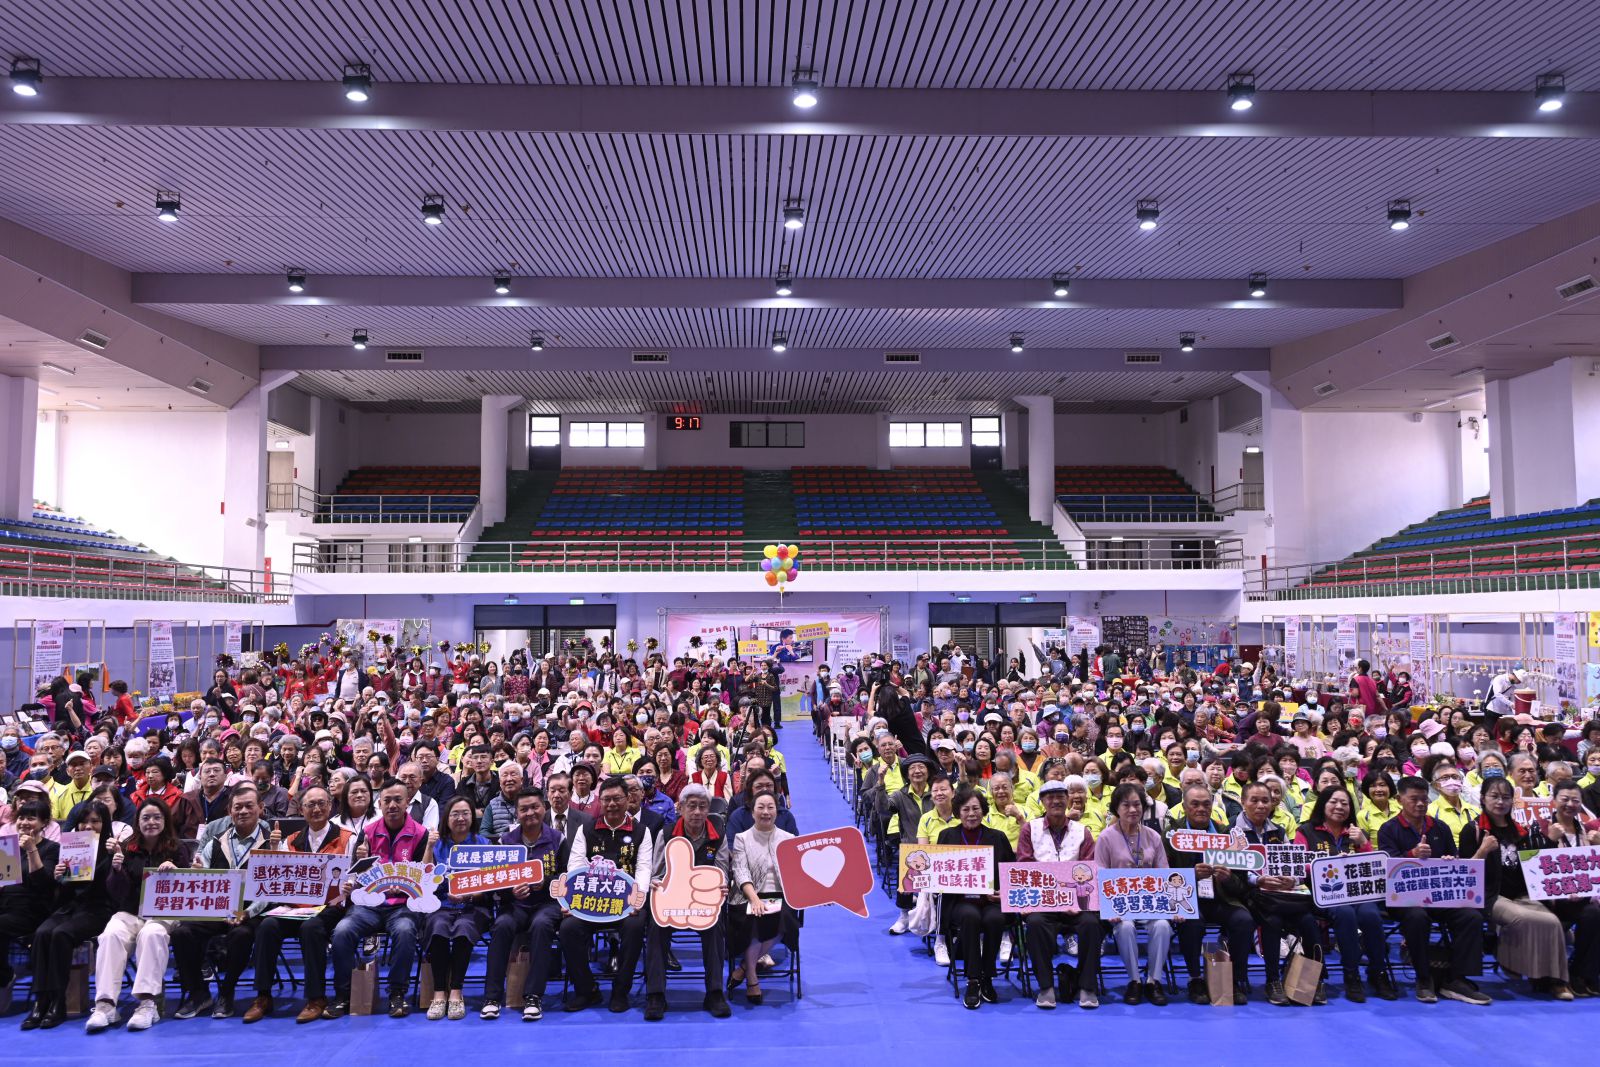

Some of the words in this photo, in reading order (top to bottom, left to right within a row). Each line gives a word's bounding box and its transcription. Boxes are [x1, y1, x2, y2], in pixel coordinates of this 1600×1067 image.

[675, 418, 700, 428] 9:17
[1177, 834, 1227, 850] 我們好
[456, 850, 520, 864] 就是愛學習
[933, 856, 986, 872] 你家長輩
[1206, 850, 1256, 868] young
[253, 864, 322, 882] 退休不褪色
[458, 866, 533, 890] 活到老學到老
[1009, 868, 1056, 888] 課業比
[1268, 865, 1304, 876] 社會處
[1344, 862, 1372, 880] 花蓮
[1401, 865, 1468, 880] 我們的第二人生
[154, 878, 232, 894] 腦力不打烊
[255, 880, 324, 898] 人生再上課
[574, 876, 626, 896] 長青大學
[938, 874, 986, 888] 也該來!
[1102, 876, 1162, 898] 長青不老!
[1346, 878, 1386, 897] 縣政府
[1394, 876, 1476, 893] 從花蓮長青大學
[154, 896, 230, 912] 學習不中斷
[570, 894, 624, 916] 真的好讚
[1008, 889, 1073, 907] 孫子還忙!
[1112, 895, 1169, 914] 學習萬歲
